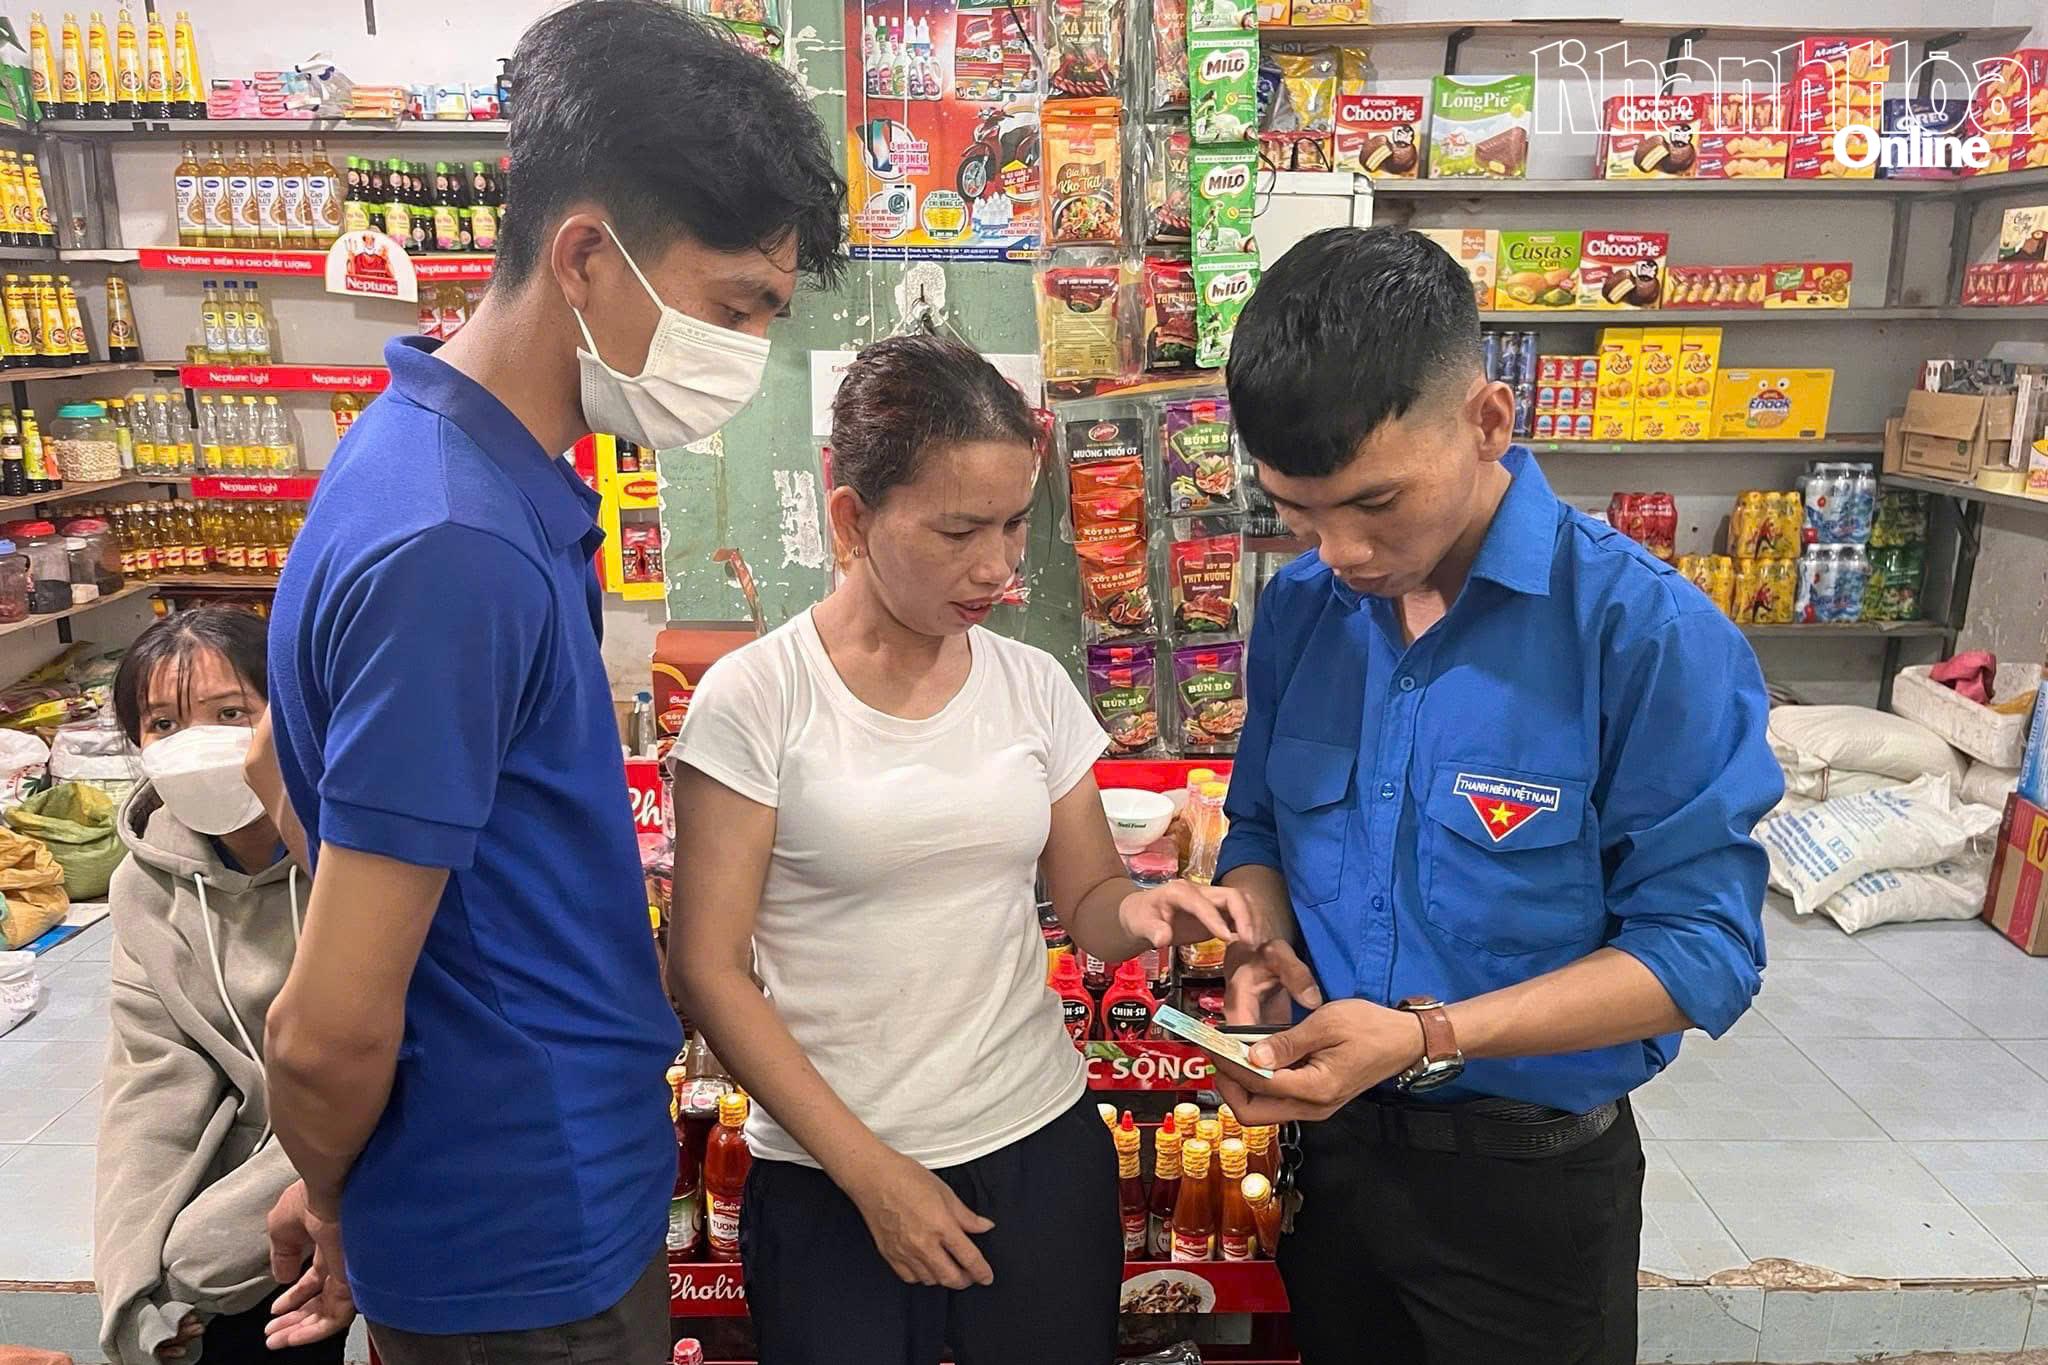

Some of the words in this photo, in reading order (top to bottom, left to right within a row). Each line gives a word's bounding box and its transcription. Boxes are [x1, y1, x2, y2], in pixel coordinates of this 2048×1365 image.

[1206, 58, 1245, 75] MILO
[1442, 92, 1509, 112] LongPie
[1342, 105, 1415, 121] ChocoPie
[1618, 104, 1694, 121] ChocoPie
[1209, 174, 1245, 190] MILO
[1510, 242, 1572, 260] Custas
[1587, 240, 1660, 257] ChocoPie
[166, 255, 211, 266] Neptune
[346, 276, 397, 293] Neptune
[1212, 280, 1247, 298] MILO
[209, 372, 249, 383] Neptune
[312, 373, 351, 385] Neptune
[219, 480, 258, 493] Neptune
[1188, 683, 1212, 694] BÚN
[1214, 681, 1232, 692] BÒ
[1102, 697, 1127, 708] BÚN
[1128, 695, 1145, 706] BÒ
[1460, 780, 1489, 794] THANH
[1488, 784, 1511, 797] NIÊN
[1512, 786, 1531, 802] VIỆT
[1531, 793, 1554, 805] NAM
[1064, 1006, 1085, 1016] IN-SU
[1112, 1007, 1146, 1017] CHIN-SU
